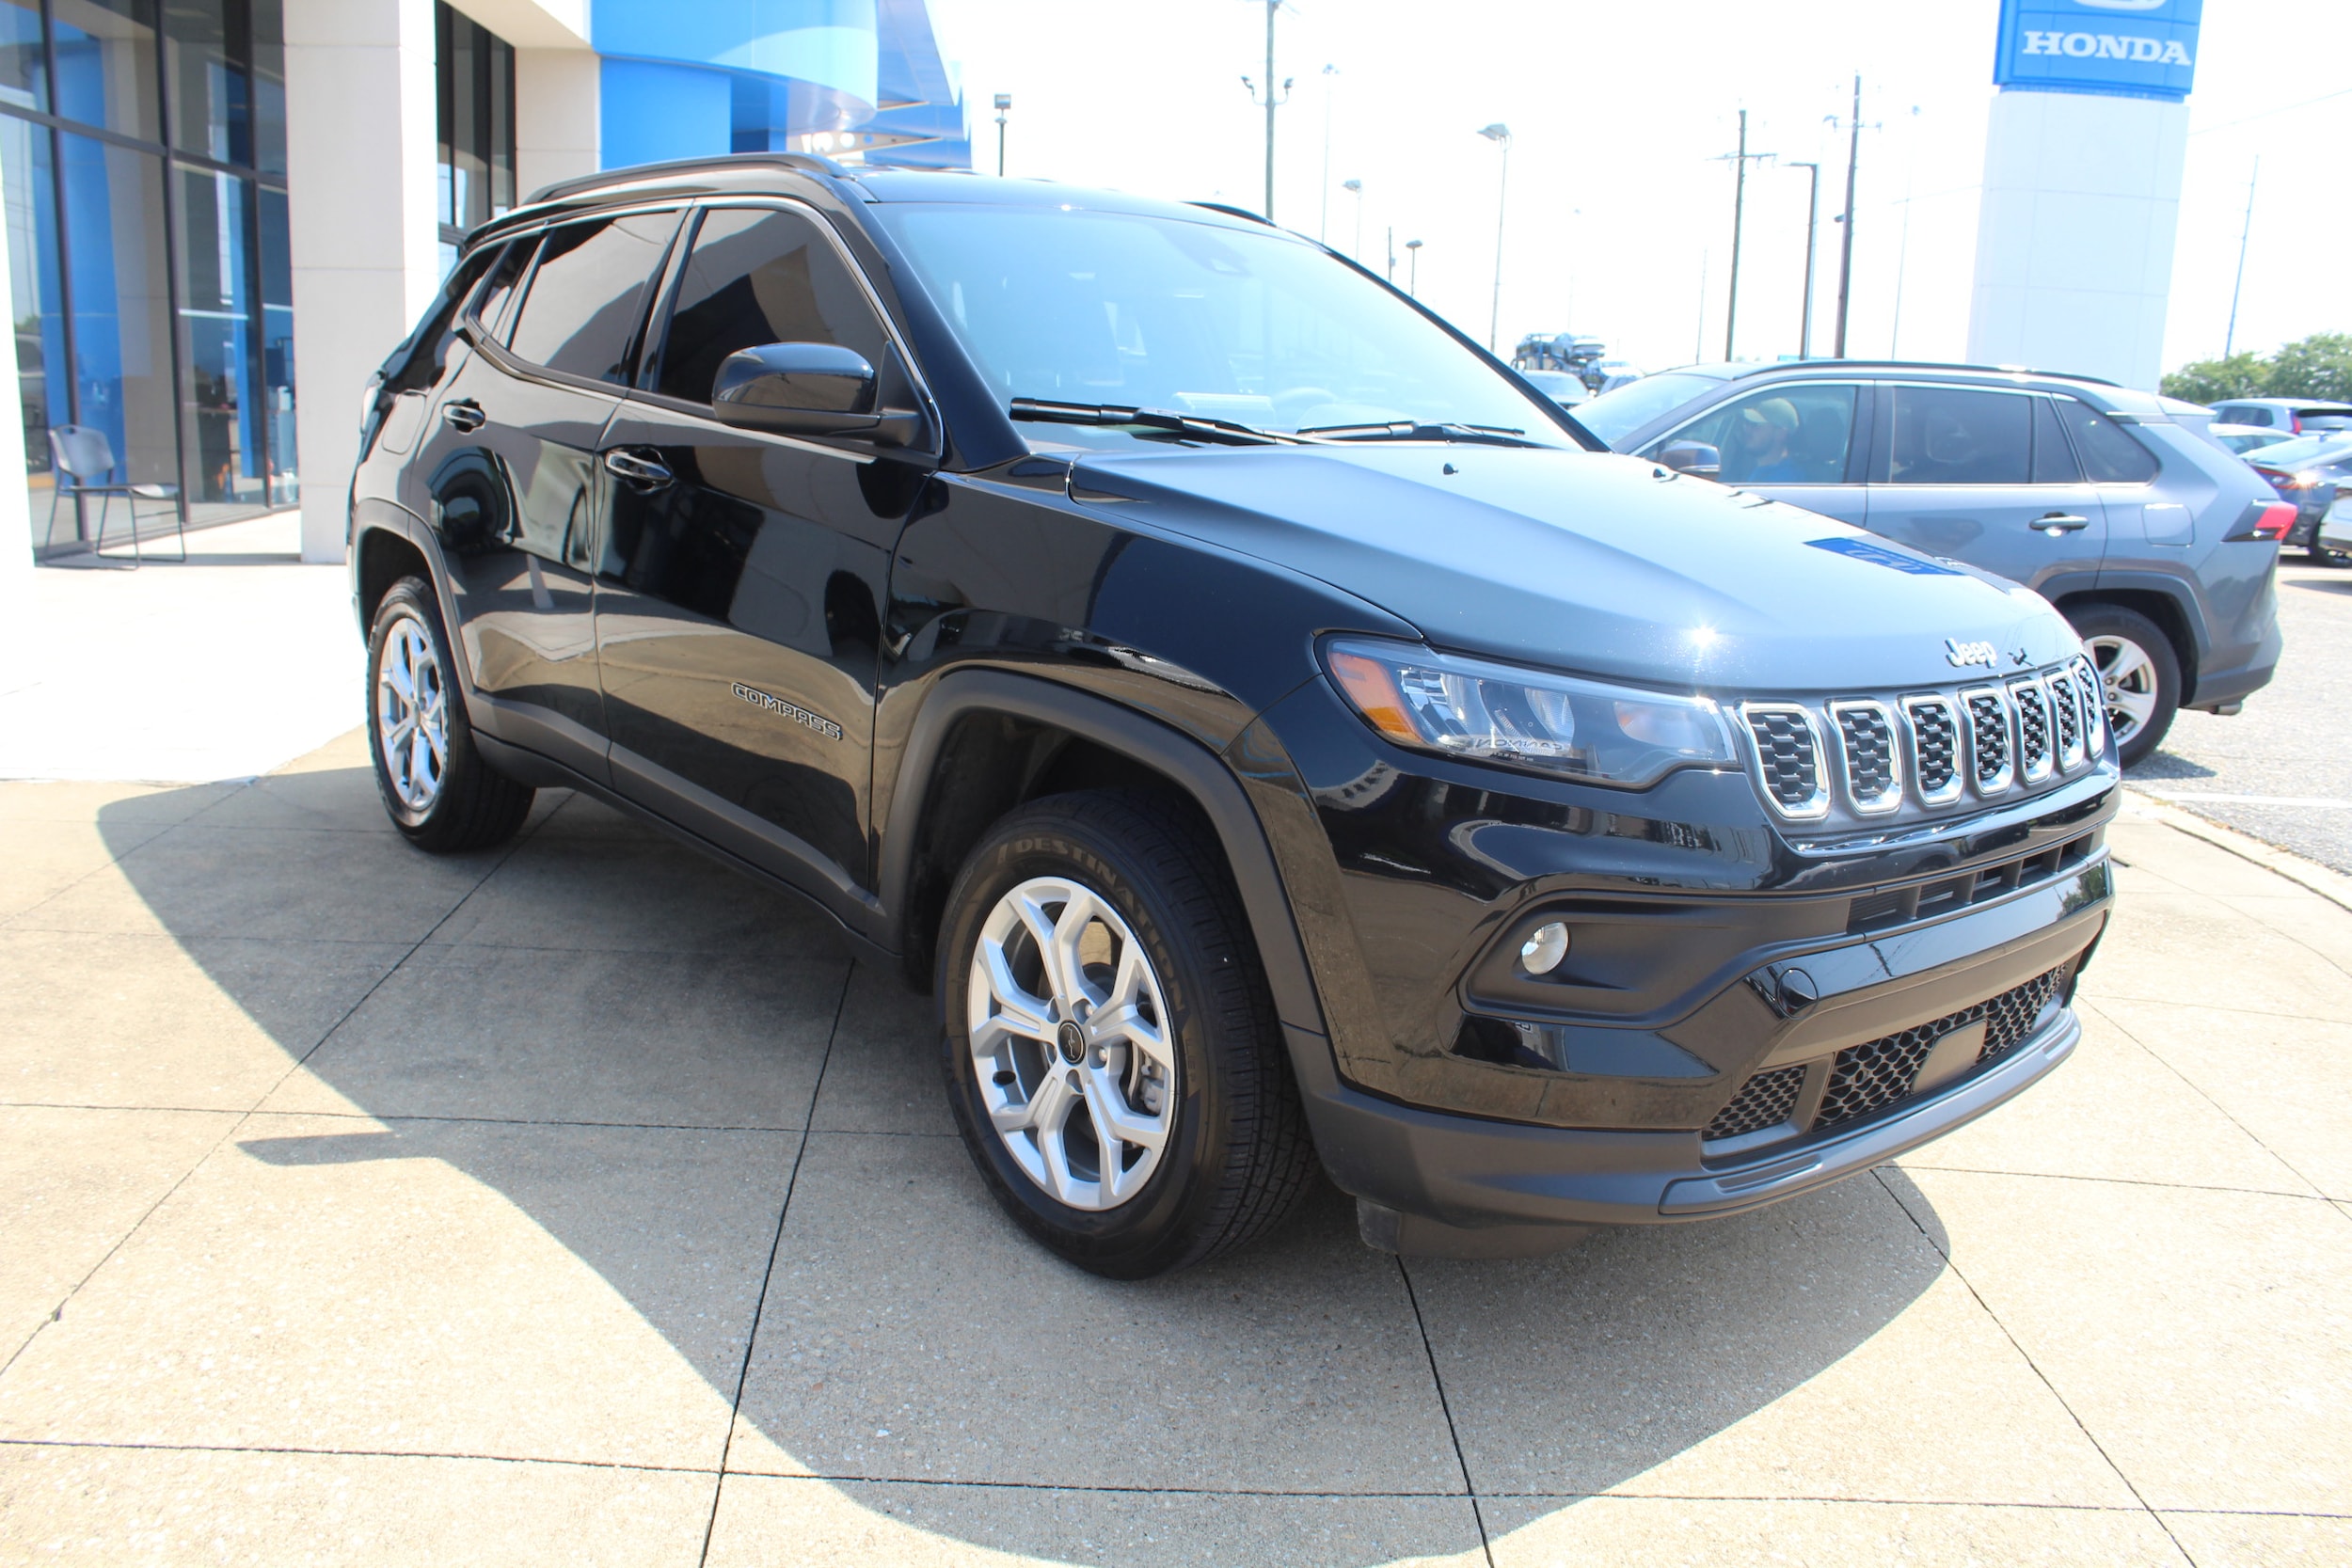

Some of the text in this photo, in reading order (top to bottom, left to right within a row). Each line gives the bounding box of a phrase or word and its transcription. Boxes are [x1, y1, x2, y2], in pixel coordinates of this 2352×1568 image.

[2022, 30, 2193, 66] HONDA
[1945, 637, 1997, 669] Jeep
[731, 682, 843, 741] COMPASS
[1015, 835, 1186, 1013] DESTINATION
